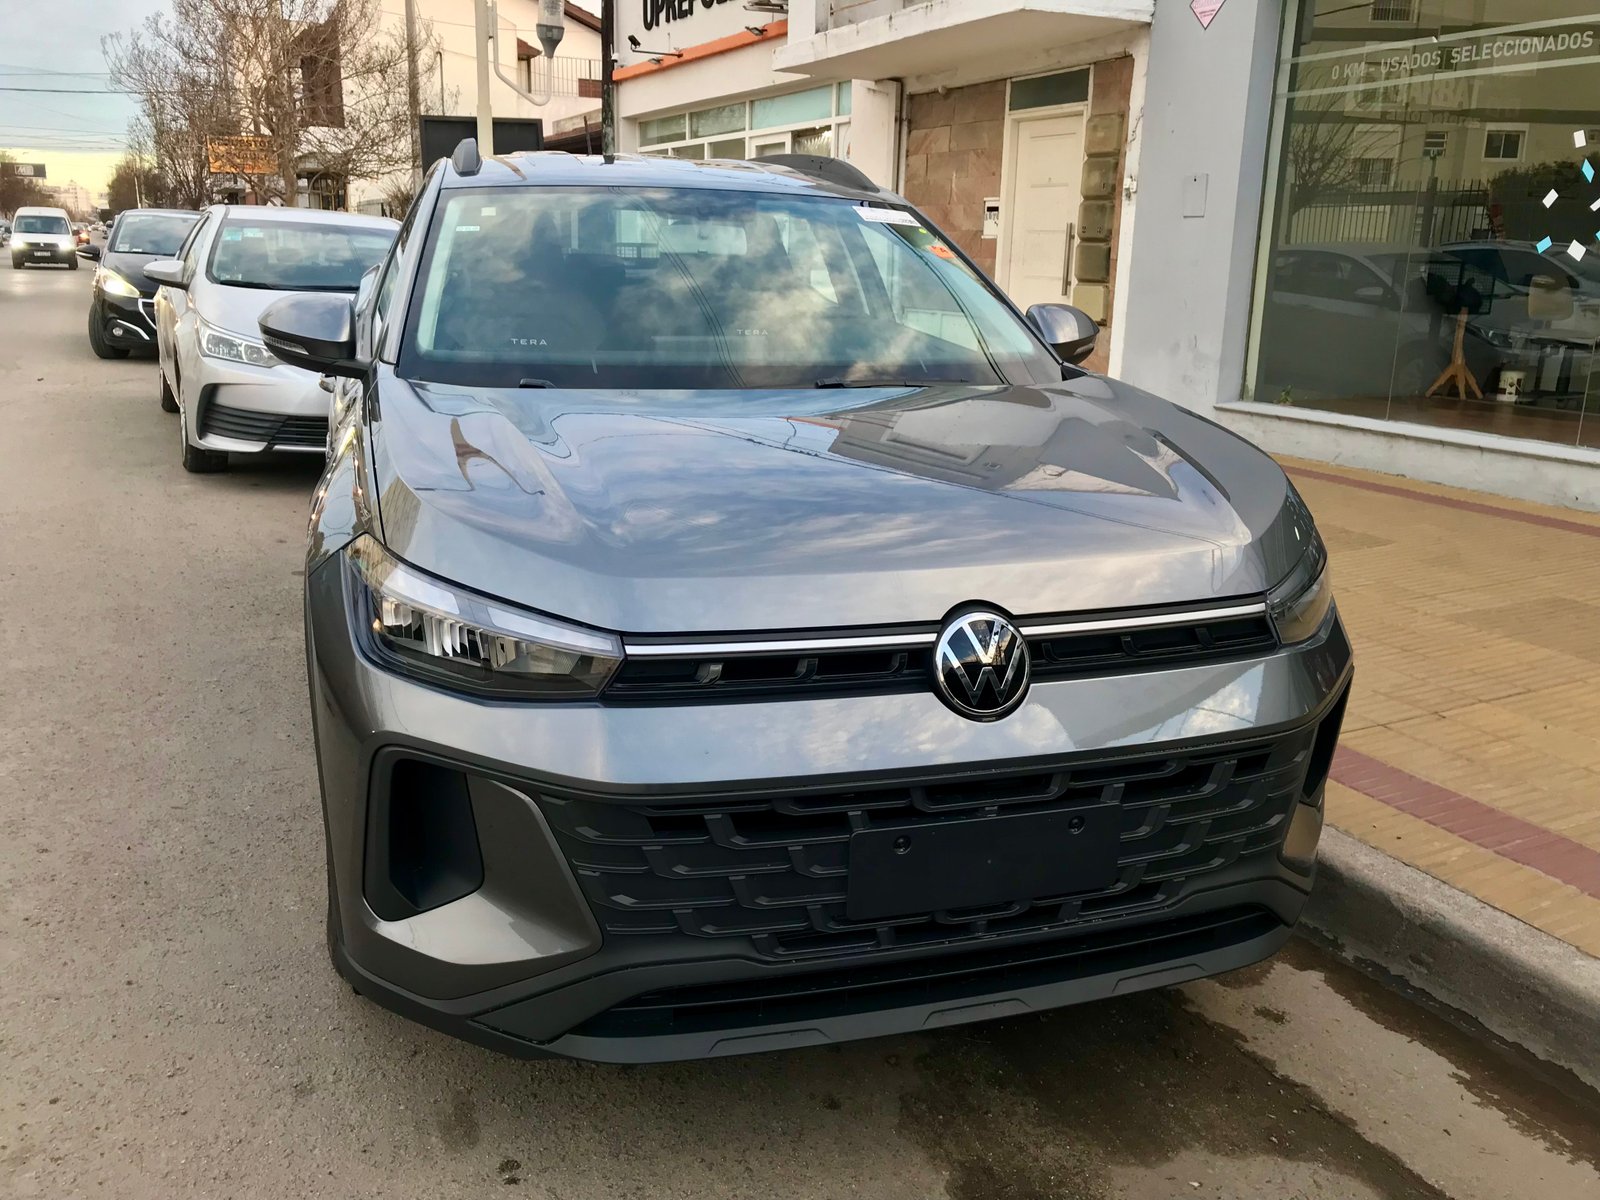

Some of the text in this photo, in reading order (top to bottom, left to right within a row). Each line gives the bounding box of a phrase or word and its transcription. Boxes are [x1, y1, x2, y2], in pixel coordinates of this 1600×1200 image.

[1331, 65, 1340, 80] 0
[1343, 61, 1366, 78] KM
[1380, 50, 1442, 73] USADOS
[1450, 30, 1594, 64] SELECCIONADOS
[736, 328, 768, 337] TERA
[510, 337, 548, 346] TERA
